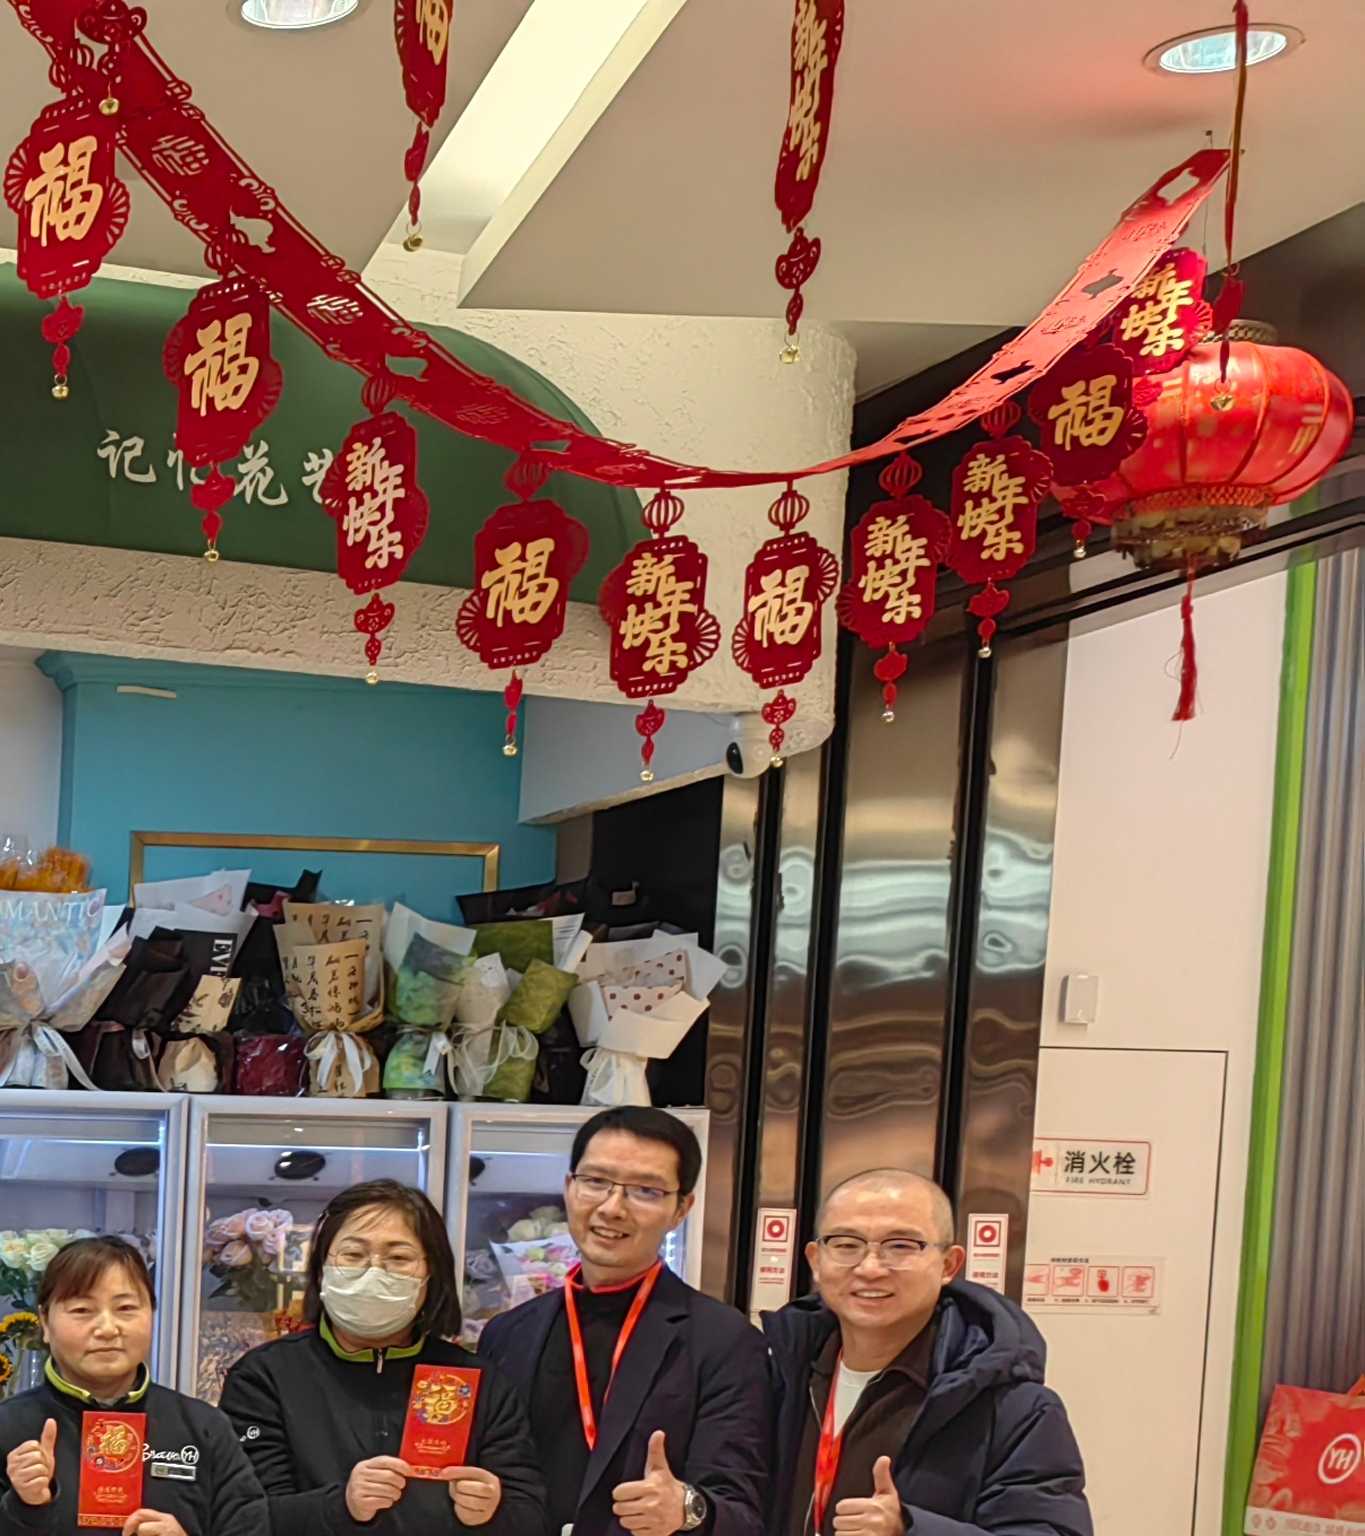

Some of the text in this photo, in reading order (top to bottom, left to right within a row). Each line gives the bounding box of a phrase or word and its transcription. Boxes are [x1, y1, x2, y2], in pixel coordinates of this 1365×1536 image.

[25, 136, 103, 245] 福
[184, 313, 260, 416] 福
[1048, 375, 1124, 450] 福
[343, 437, 406, 570] 新年快乐
[956, 453, 1029, 562] 新年快乐
[481, 538, 560, 628] 福
[619, 554, 695, 676] 新年快乐
[748, 565, 813, 648] 福
[859, 515, 931, 625] 新年快乐
[1064, 1149, 1136, 1175] 消火栓
[1065, 1177, 1084, 1185] FIRE
